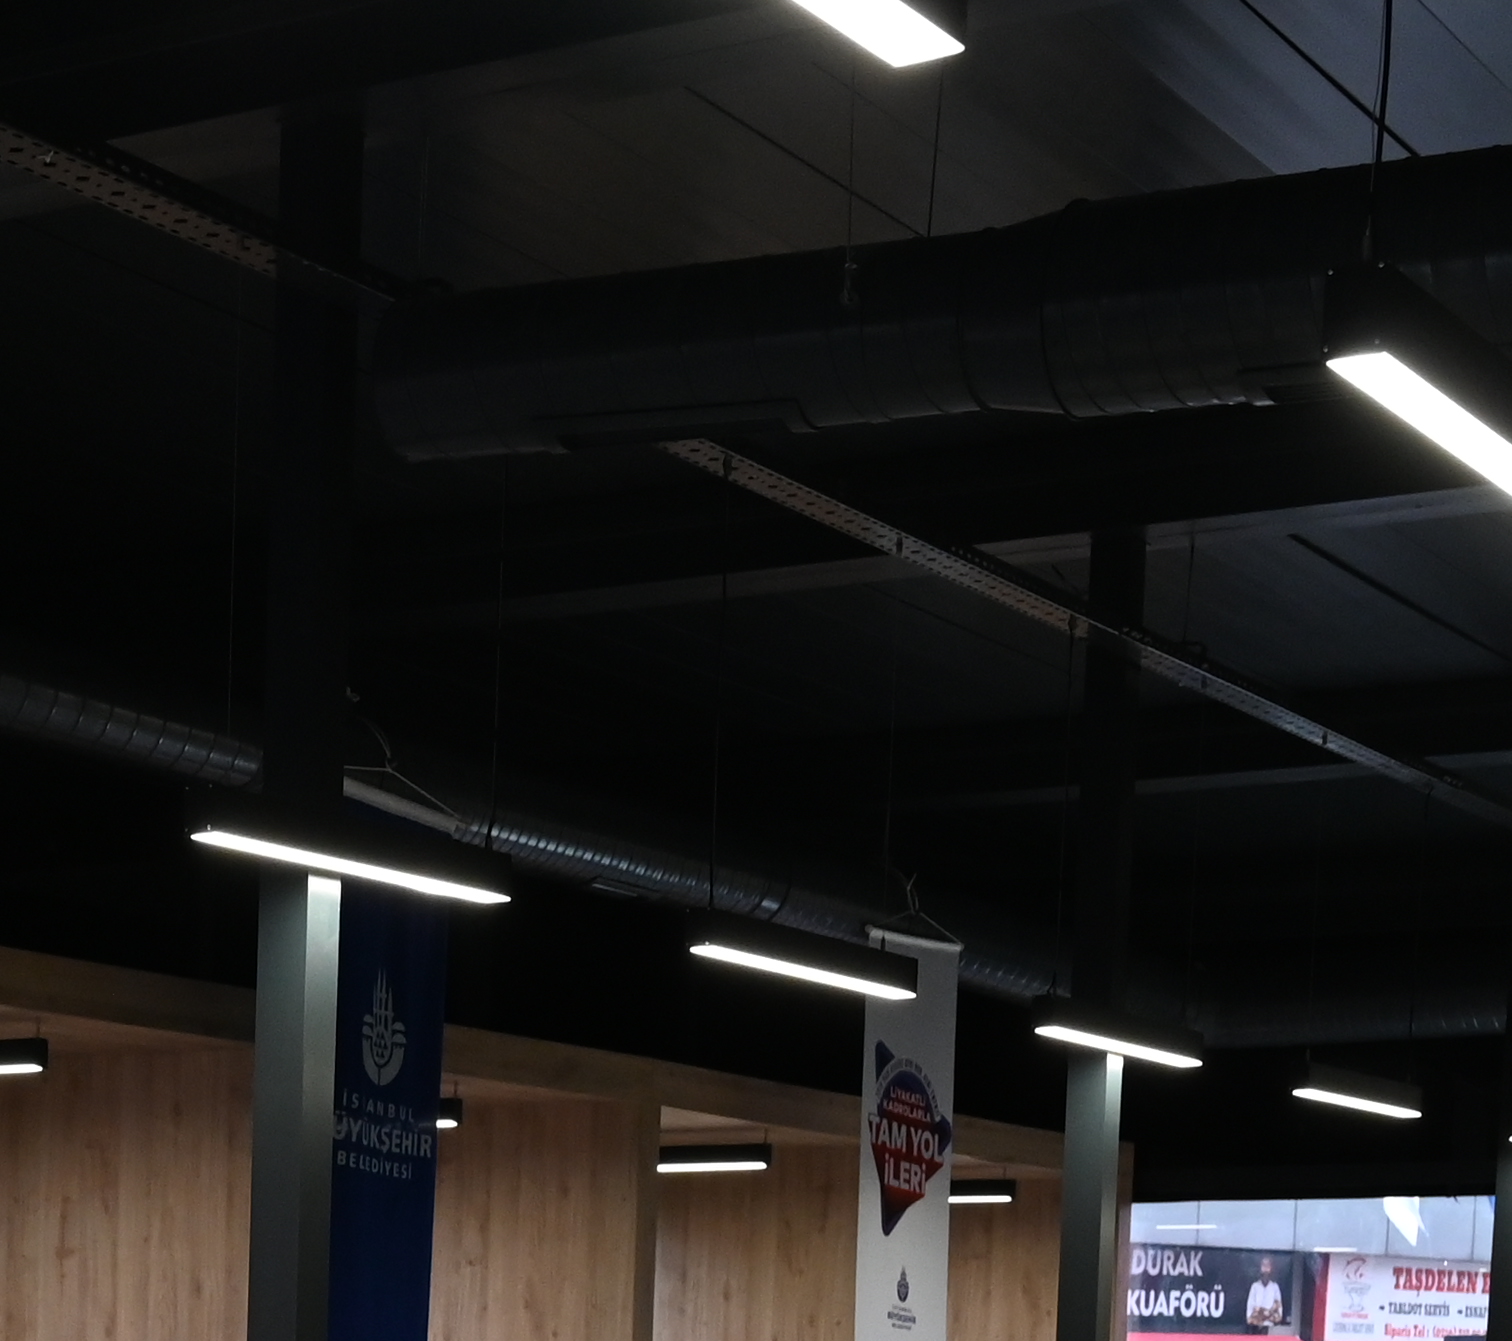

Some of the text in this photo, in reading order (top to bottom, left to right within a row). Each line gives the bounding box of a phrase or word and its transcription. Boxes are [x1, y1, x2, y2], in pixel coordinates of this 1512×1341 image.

[882, 1098, 931, 1122] KADROLARLA
[868, 1112, 945, 1163] TAM YOL
[336, 1149, 413, 1180] BELEDİYESİ
[884, 1152, 926, 1194] İLERİ
[1131, 1249, 1203, 1277] DURAK
[1392, 1266, 1479, 1298] TAŞDELEN
[1126, 1284, 1225, 1318] KUAFÖRÜ
